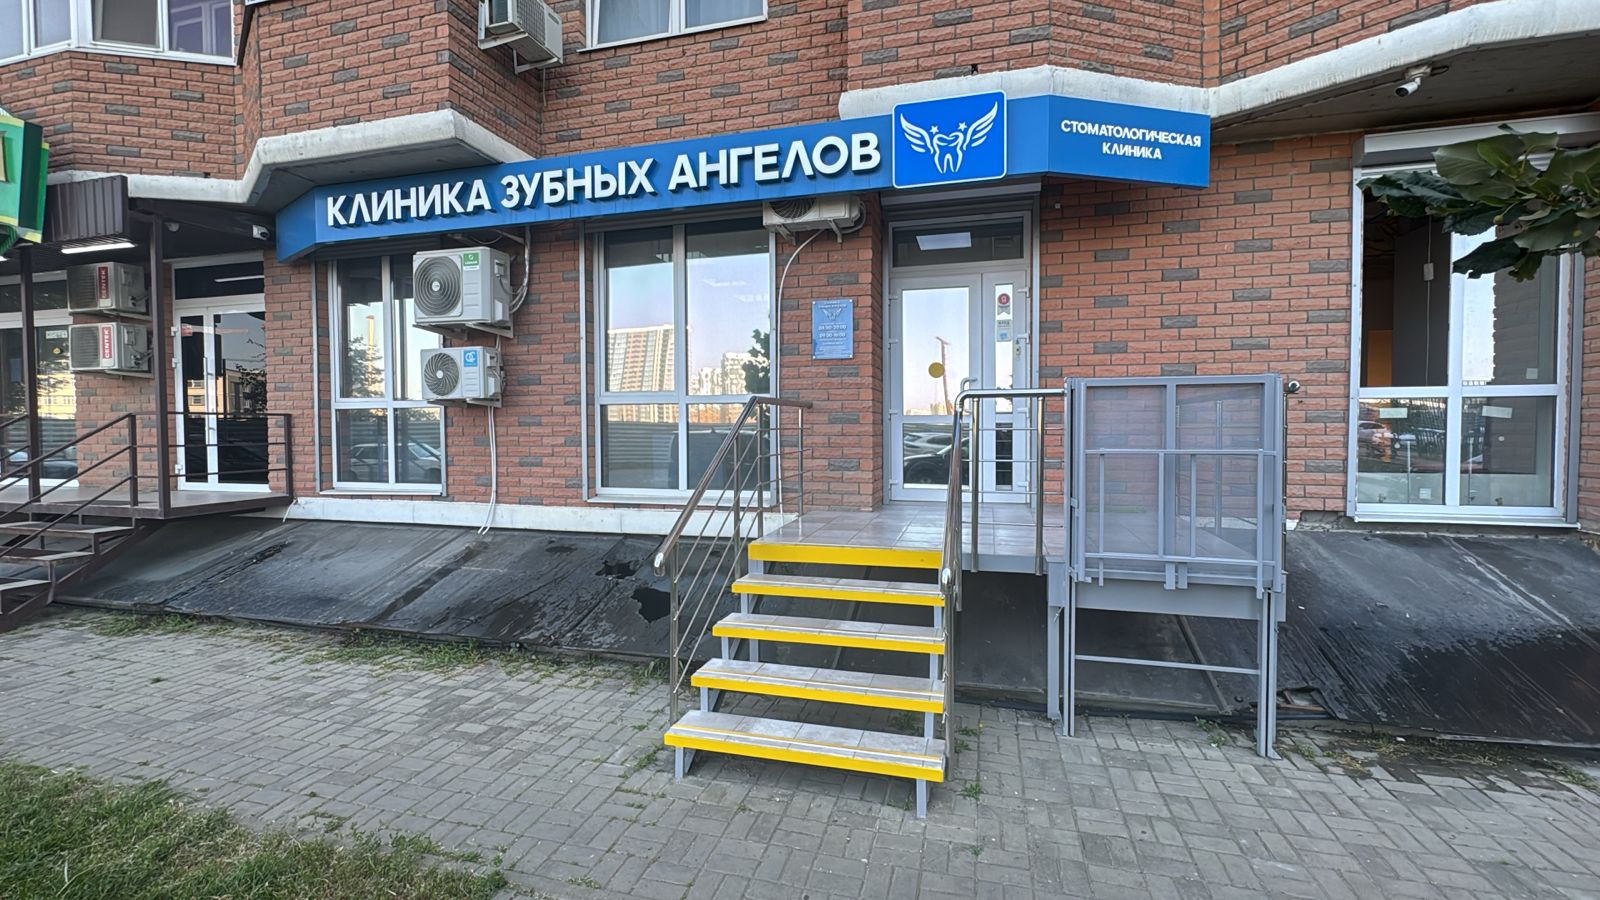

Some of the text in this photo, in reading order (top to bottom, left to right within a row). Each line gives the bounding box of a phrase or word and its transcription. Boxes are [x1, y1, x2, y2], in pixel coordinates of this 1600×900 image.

[1061, 119, 1202, 148] СТОМАТОЛОГИЧЕСКАЯ
[1102, 142, 1162, 160] КЛИНИКА
[327, 132, 881, 226] КЛИНИКА ЗУБНЫХ АНГЕЛОВ
